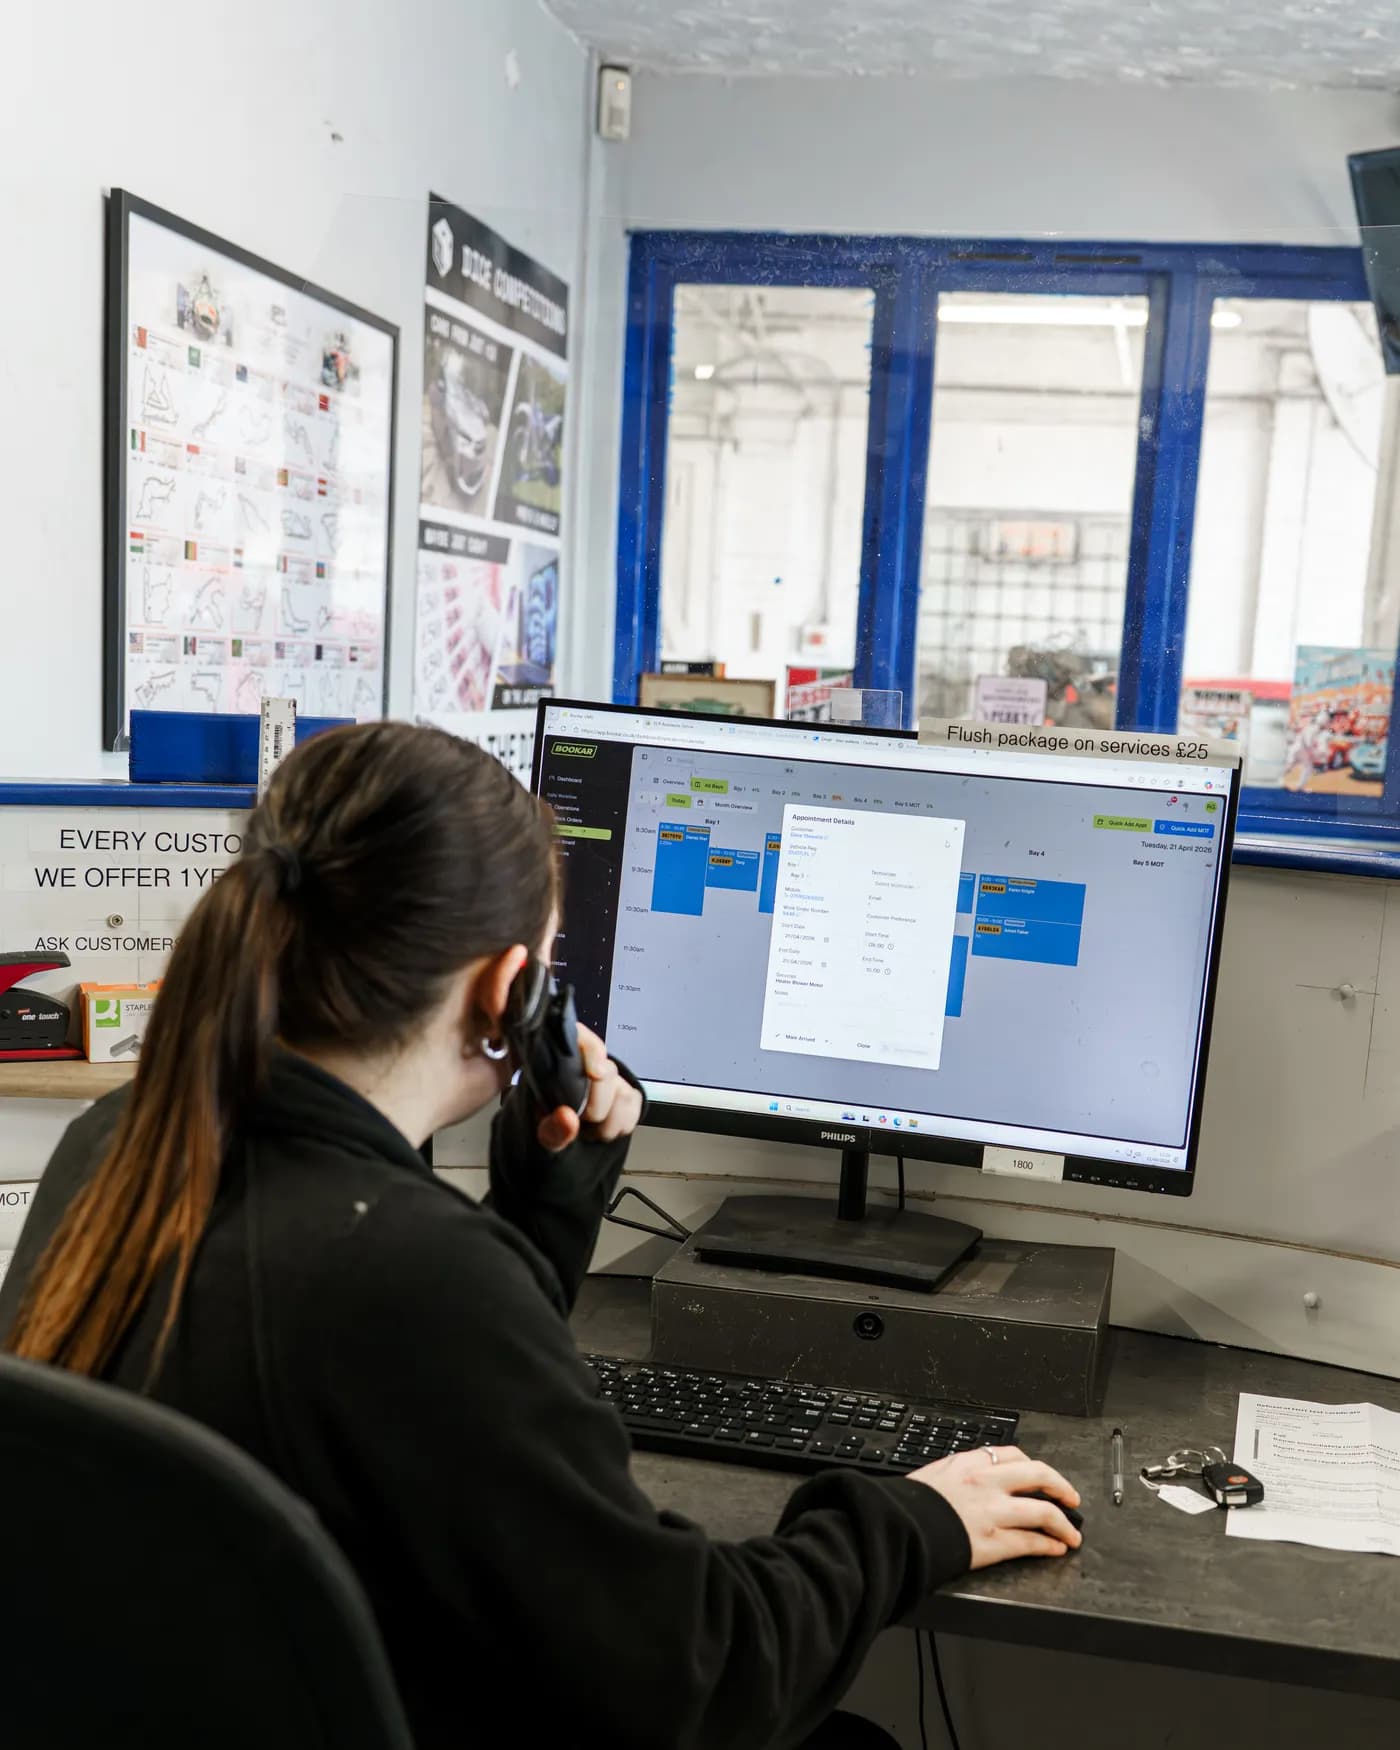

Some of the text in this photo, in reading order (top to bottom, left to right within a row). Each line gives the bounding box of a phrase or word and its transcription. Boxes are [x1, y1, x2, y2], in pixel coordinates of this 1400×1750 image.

[947, 725, 1208, 760] Flush package on services £25
[554, 744, 594, 756] BOOKAR
[730, 803, 753, 811] Overview
[704, 818, 717, 826] Bay
[791, 813, 855, 826] Appointment Details
[60, 829, 147, 851] EVERY
[1028, 849, 1040, 857] Bay
[1141, 840, 1168, 850] Tuesday,
[1178, 844, 1194, 852] April
[1194, 846, 1213, 854] 2026
[1132, 859, 1144, 867] Bay
[35, 868, 76, 888] WE
[84, 867, 170, 888] OFFER
[35, 937, 69, 951] ASK
[22, 1012, 60, 1021] one touch
[820, 1130, 856, 1143] PHILIPS
[1012, 1159, 1034, 1170] 1800
